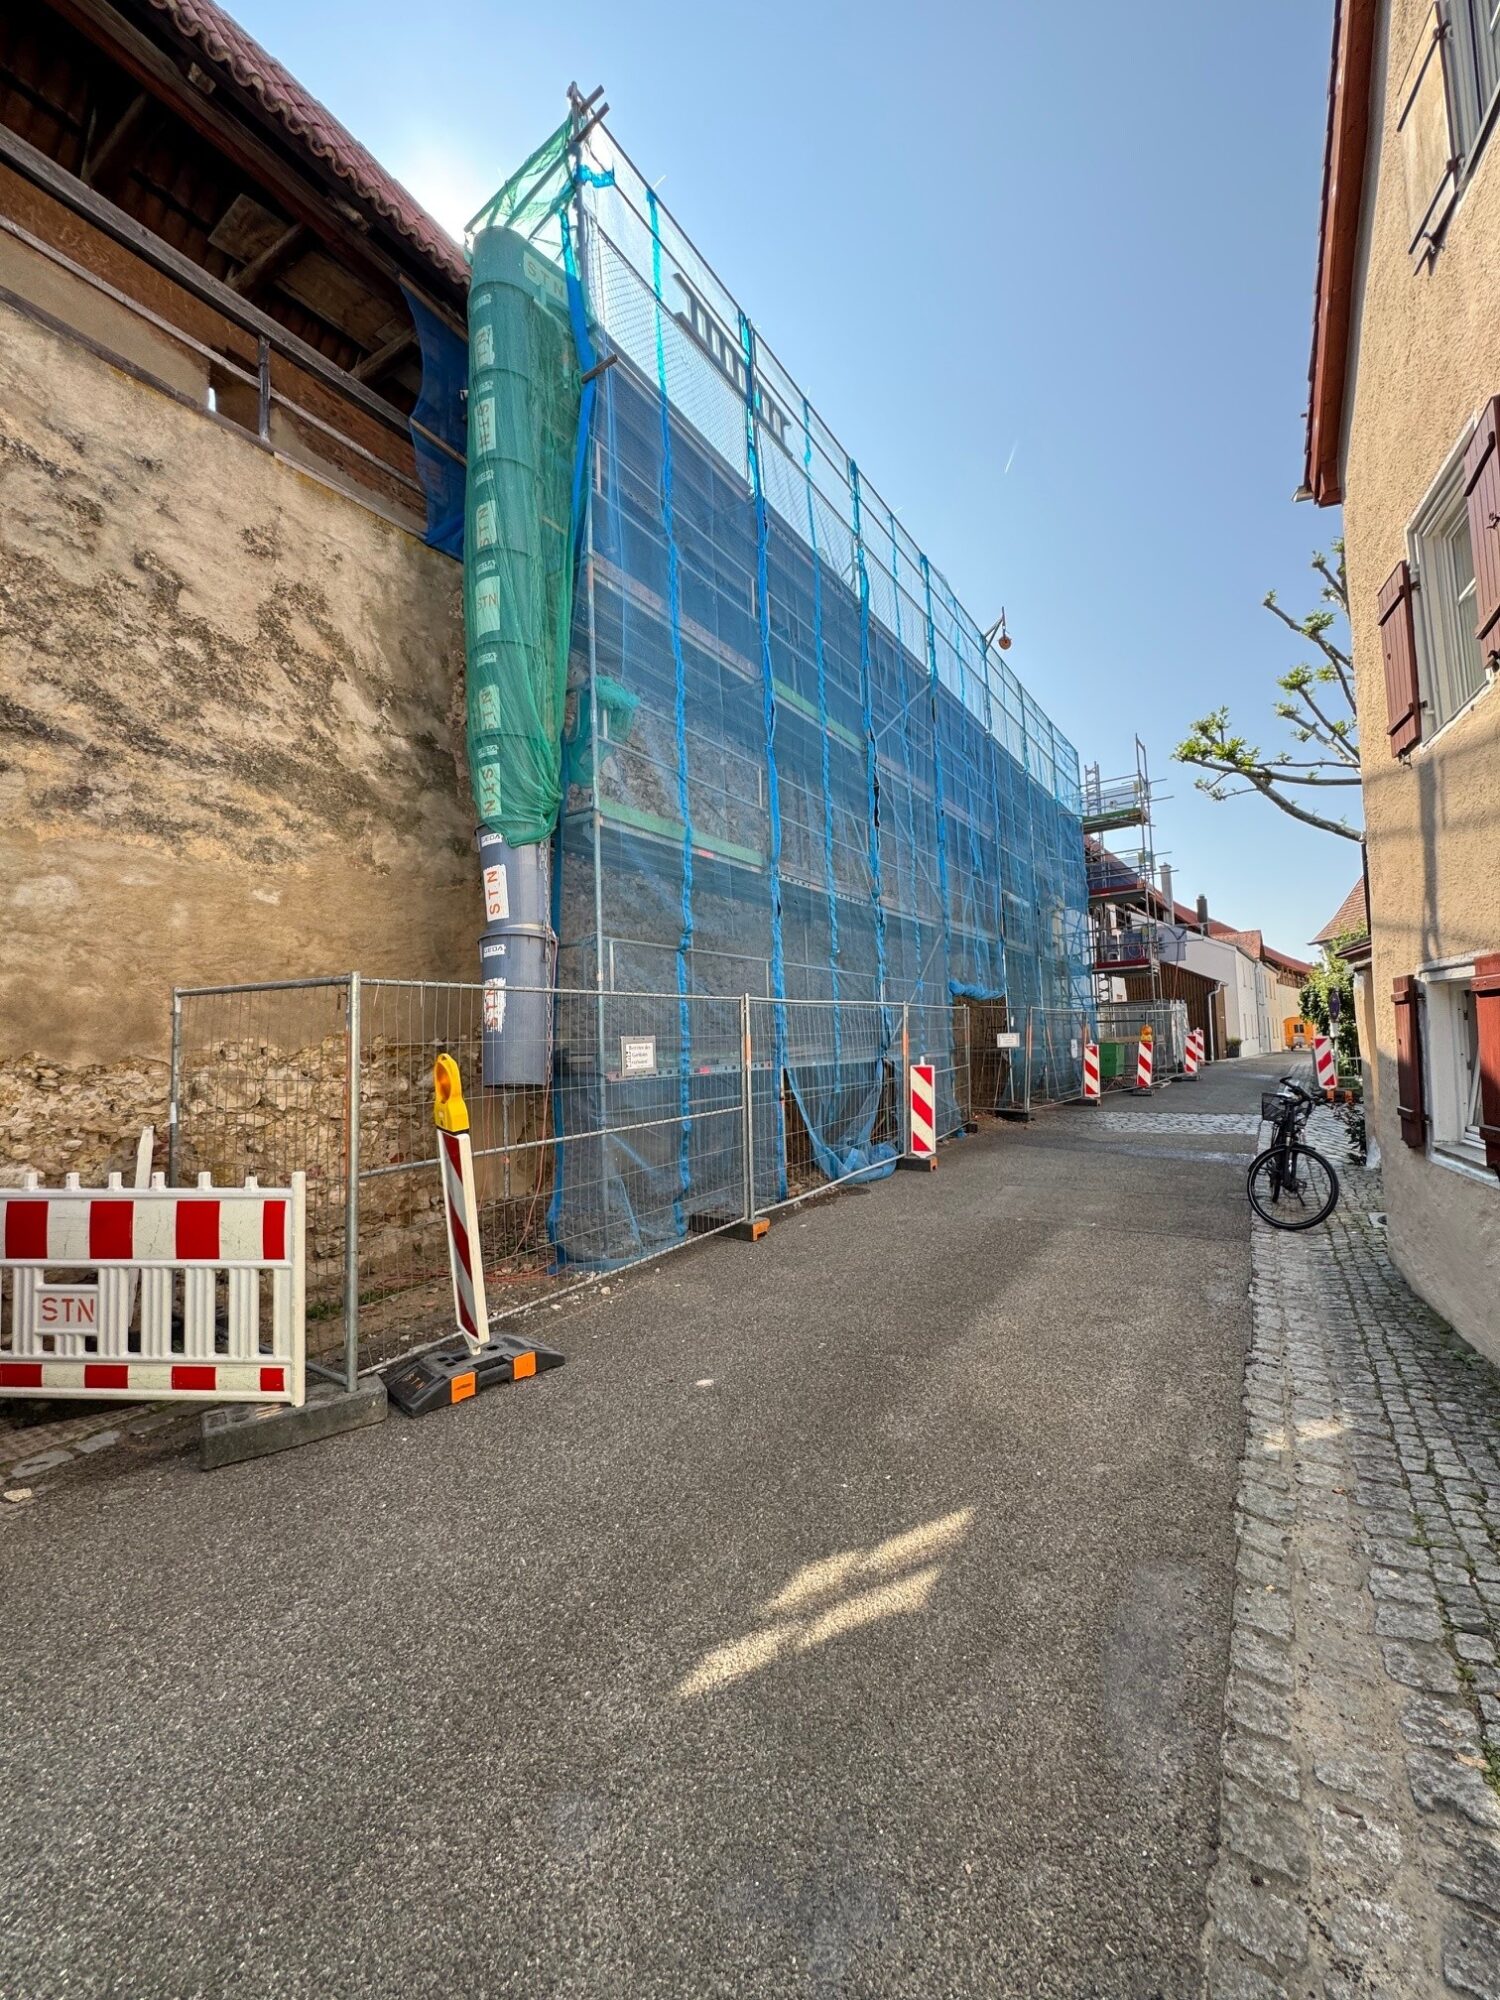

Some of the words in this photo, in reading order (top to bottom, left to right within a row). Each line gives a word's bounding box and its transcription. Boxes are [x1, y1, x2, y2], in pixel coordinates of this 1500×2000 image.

[527, 260, 564, 298] STN
[476, 592, 498, 612] STN
[482, 767, 496, 813] STN
[486, 870, 501, 915] STN
[42, 1297, 94, 1322] STN
